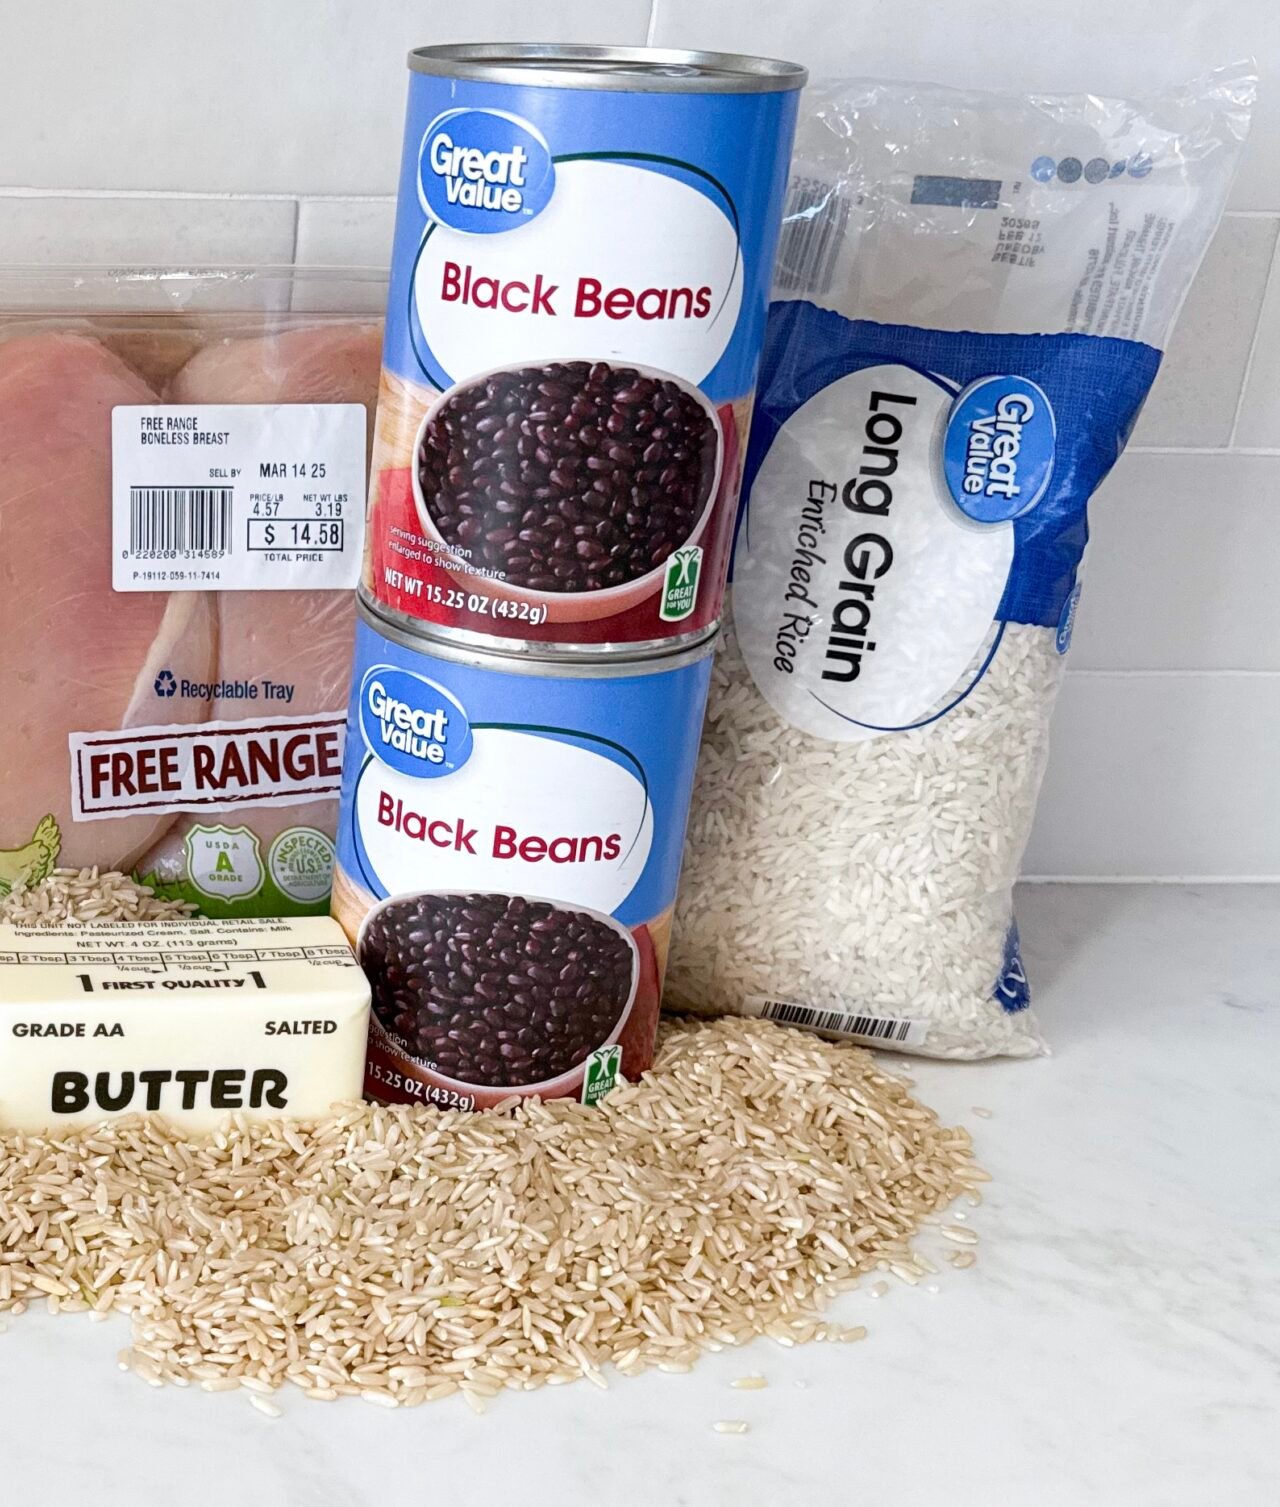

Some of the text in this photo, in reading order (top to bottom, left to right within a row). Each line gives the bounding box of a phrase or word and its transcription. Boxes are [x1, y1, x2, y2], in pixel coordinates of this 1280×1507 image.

[430, 132, 527, 185] Great
[445, 174, 522, 213] Value
[441, 261, 711, 321] Black Beans
[141, 417, 198, 431] FREE RANGE
[141, 432, 230, 445] BONELESS BREAST
[985, 393, 1034, 498] Great
[964, 416, 996, 494] Value
[209, 463, 326, 478] SELL BY MAR 14 25
[249, 493, 348, 502] PRICE/LB NET WT LBS
[252, 503, 342, 517] 4.57 3.19
[264, 523, 339, 545] $ 14.58
[389, 525, 472, 559] serving suggestion
[821, 391, 917, 683] Long Grain
[122, 550, 225, 559] 0 220200 314589
[264, 553, 324, 562] TOTAL PRICE
[388, 541, 507, 581] enlarged to show texture
[774, 479, 838, 675] Enriched Rice
[385, 566, 548, 626] NET WT 15.25 OZ (432g)
[666, 598, 691, 611] FOR YOU
[668, 585, 693, 601] GREAT
[181, 679, 294, 703] Recyclable Tray
[368, 681, 448, 743] Great
[380, 721, 447, 766] Value
[90, 732, 342, 799] FREE RANGE
[377, 791, 622, 864] Black Beans
[205, 841, 240, 850] USDA
[277, 836, 331, 864] INSPECTED
[215, 852, 235, 873] A
[208, 873, 243, 883] GRADE
[14, 930, 77, 938] Ingredients:
[166, 940, 194, 948] (113
[196, 939, 238, 947] grams)
[76, 971, 267, 992] 1 FIRST QUALITY 1
[12, 1020, 338, 1038] GRADE AA SALTED
[375, 1039, 438, 1071] show texture
[50, 1068, 288, 1114] BUTTER
[368, 1062, 476, 1111] 15.25 OZ (432g)
[588, 1077, 614, 1093] GREAT
